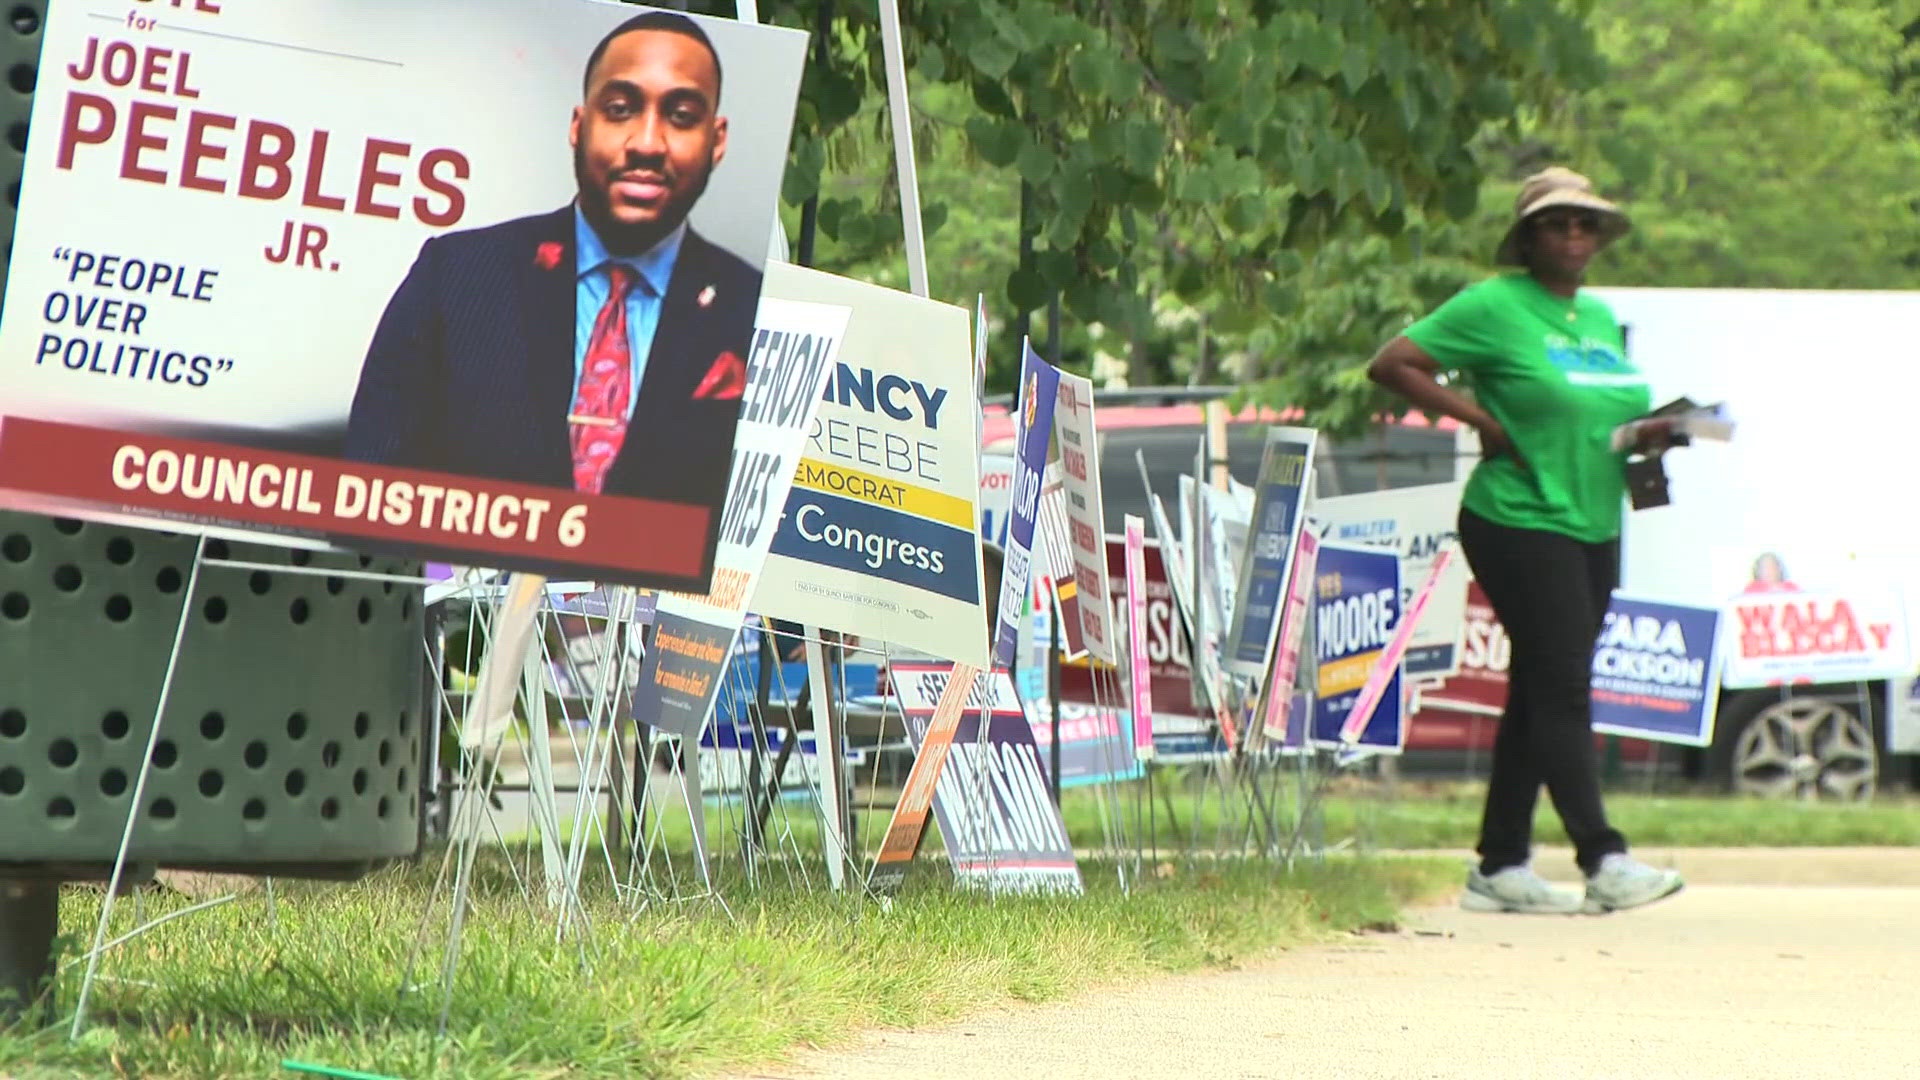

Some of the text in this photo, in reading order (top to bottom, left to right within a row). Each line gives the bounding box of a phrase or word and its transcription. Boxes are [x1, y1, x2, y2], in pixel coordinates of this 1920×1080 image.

[124, 9, 158, 32] for
[66, 36, 201, 99] JOEL
[56, 90, 472, 228] PEEBLES
[263, 220, 341, 272] JR.
[43, 291, 148, 336] OVER
[738, 329, 832, 430] EENON
[111, 444, 322, 515] COUNCIL
[333, 474, 551, 542] DISTRICT
[558, 505, 588, 547] 6
[719, 449, 781, 548] MES
[796, 503, 945, 575] Congress
[1318, 588, 1395, 660] MOORE
